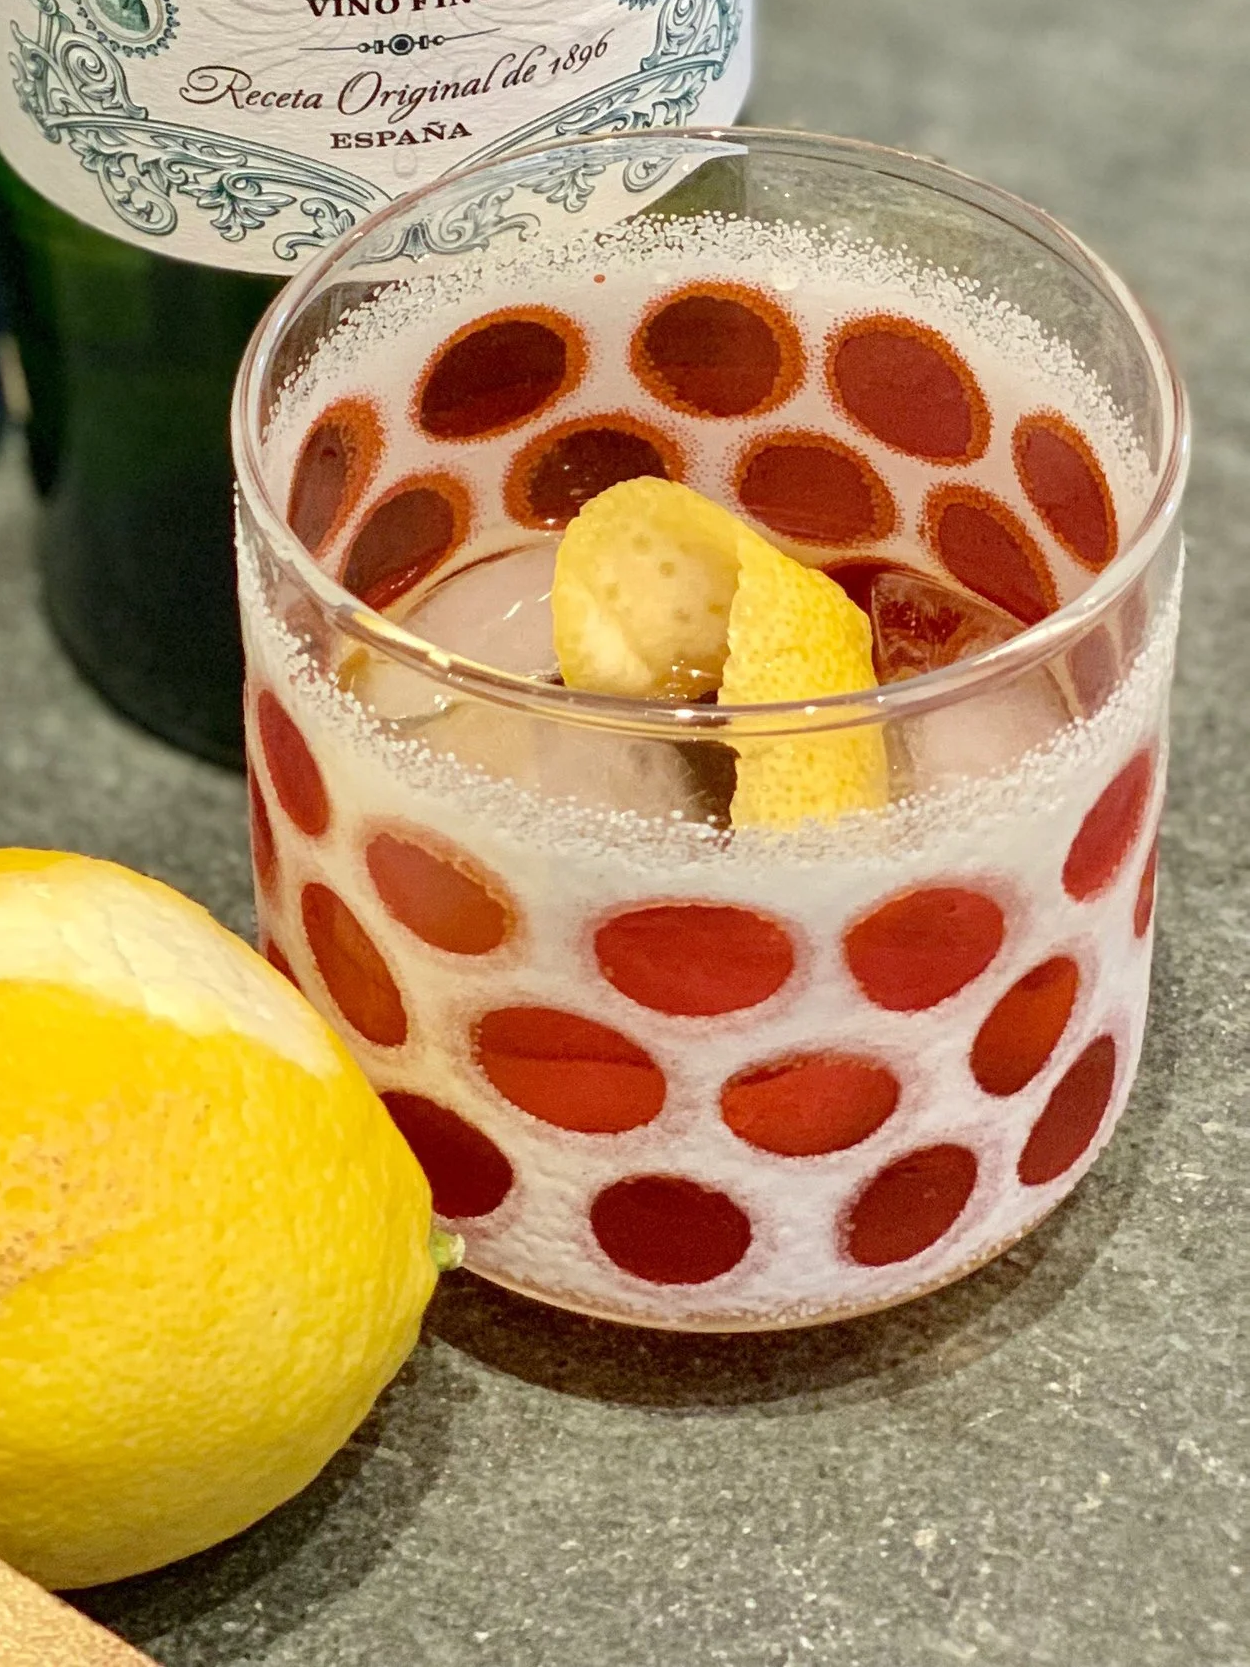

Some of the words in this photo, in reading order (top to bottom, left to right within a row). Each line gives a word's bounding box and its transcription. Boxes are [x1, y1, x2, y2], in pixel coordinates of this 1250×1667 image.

[178, 65, 324, 110] Receta
[337, 53, 505, 125] Original
[501, 43, 547, 90] de
[548, 27, 616, 76] 1896
[330, 121, 473, 151] ESPAÑA
